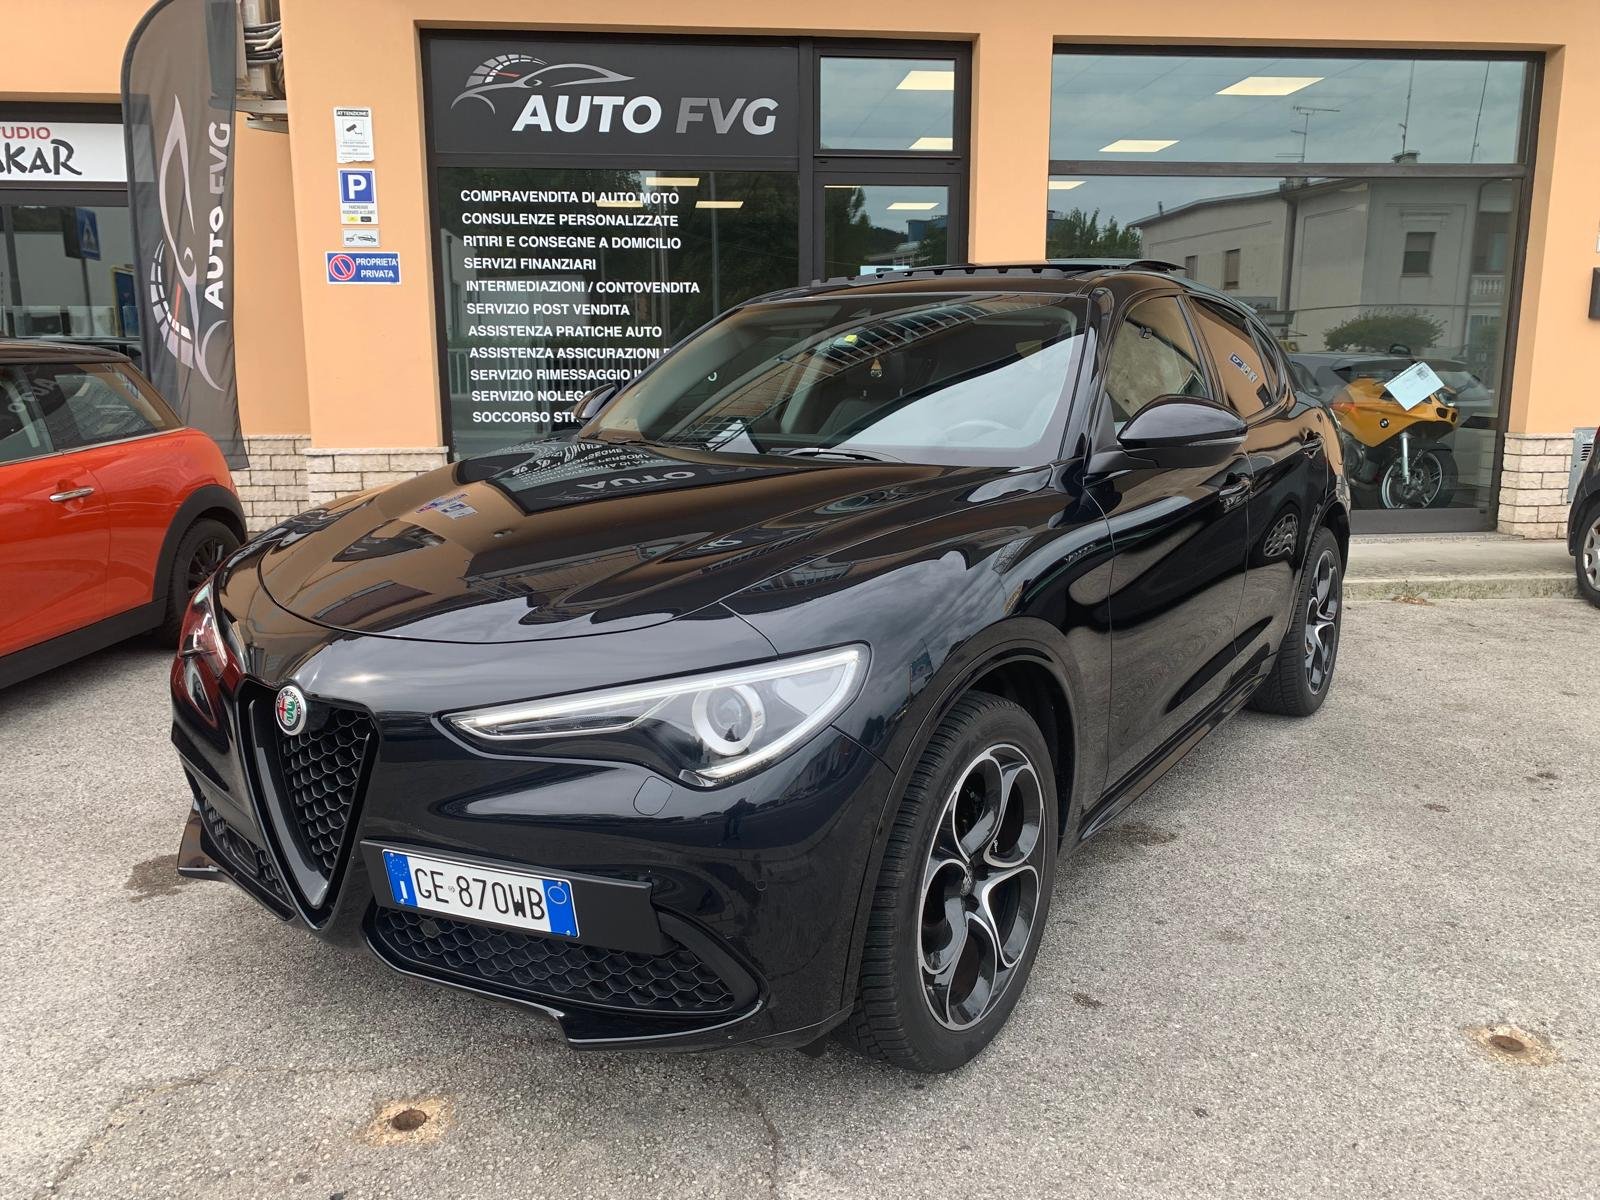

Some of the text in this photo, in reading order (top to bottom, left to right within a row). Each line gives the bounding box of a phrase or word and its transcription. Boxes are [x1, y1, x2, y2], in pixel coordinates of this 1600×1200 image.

[511, 95, 780, 136] AUTO FVG
[0, 126, 51, 140] UDIO
[347, 174, 367, 200] P
[460, 190, 680, 204] COMPRAVENDITA DI AUTO MOTO
[462, 213, 679, 227] CONSULENZE PERSONALIZZATE
[463, 235, 682, 250] RITIRI E CONSEGNE A DOMICILIO
[204, 205, 224, 310] AUTO
[463, 257, 597, 270] SERVIZI FINANZIARI
[360, 269, 395, 278] PRIVATA
[466, 280, 585, 293] INTERMEDIAZIONI
[596, 282, 701, 294] CONTOVENDITA
[466, 303, 631, 316] SERVIZIO POST VENDITA
[468, 325, 663, 338] ASSISTENZA PRATICHE AUTO
[469, 347, 554, 359] ASSISTENZA
[556, 347, 660, 359] ASSICURAZIONI
[470, 369, 533, 381] SERVIZIO
[536, 369, 631, 381] RIMESSAGGIO
[471, 390, 534, 402] SERVIZIO
[472, 411, 550, 423] SOCCORSO
[414, 868, 449, 904] GE
[456, 875, 546, 921] 870WB
